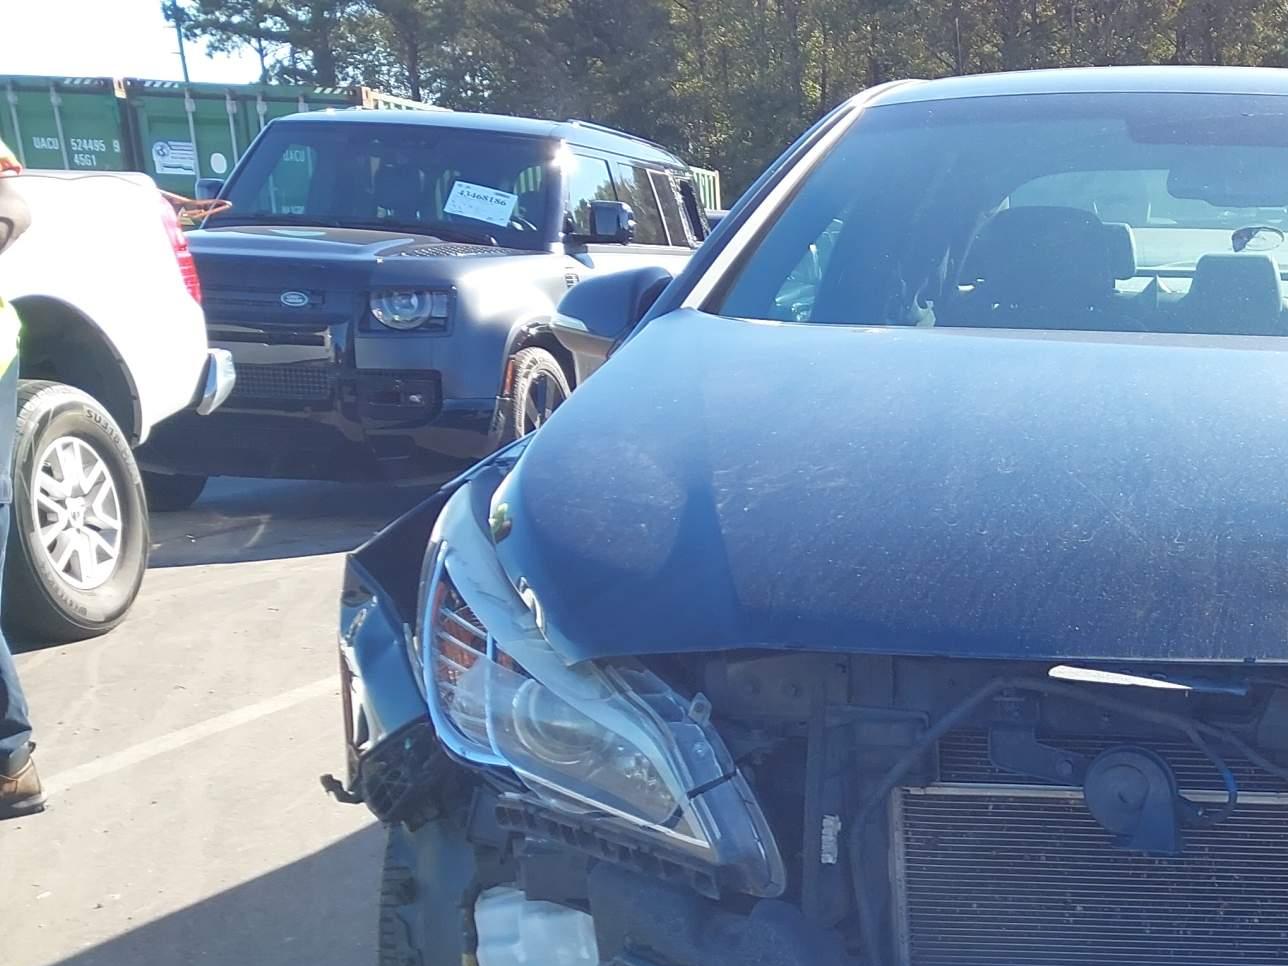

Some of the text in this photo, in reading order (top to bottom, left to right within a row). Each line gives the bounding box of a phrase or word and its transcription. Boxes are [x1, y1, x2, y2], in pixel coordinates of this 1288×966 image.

[32, 137, 120, 152] UACU 524495 9
[73, 154, 97, 166] 45G1
